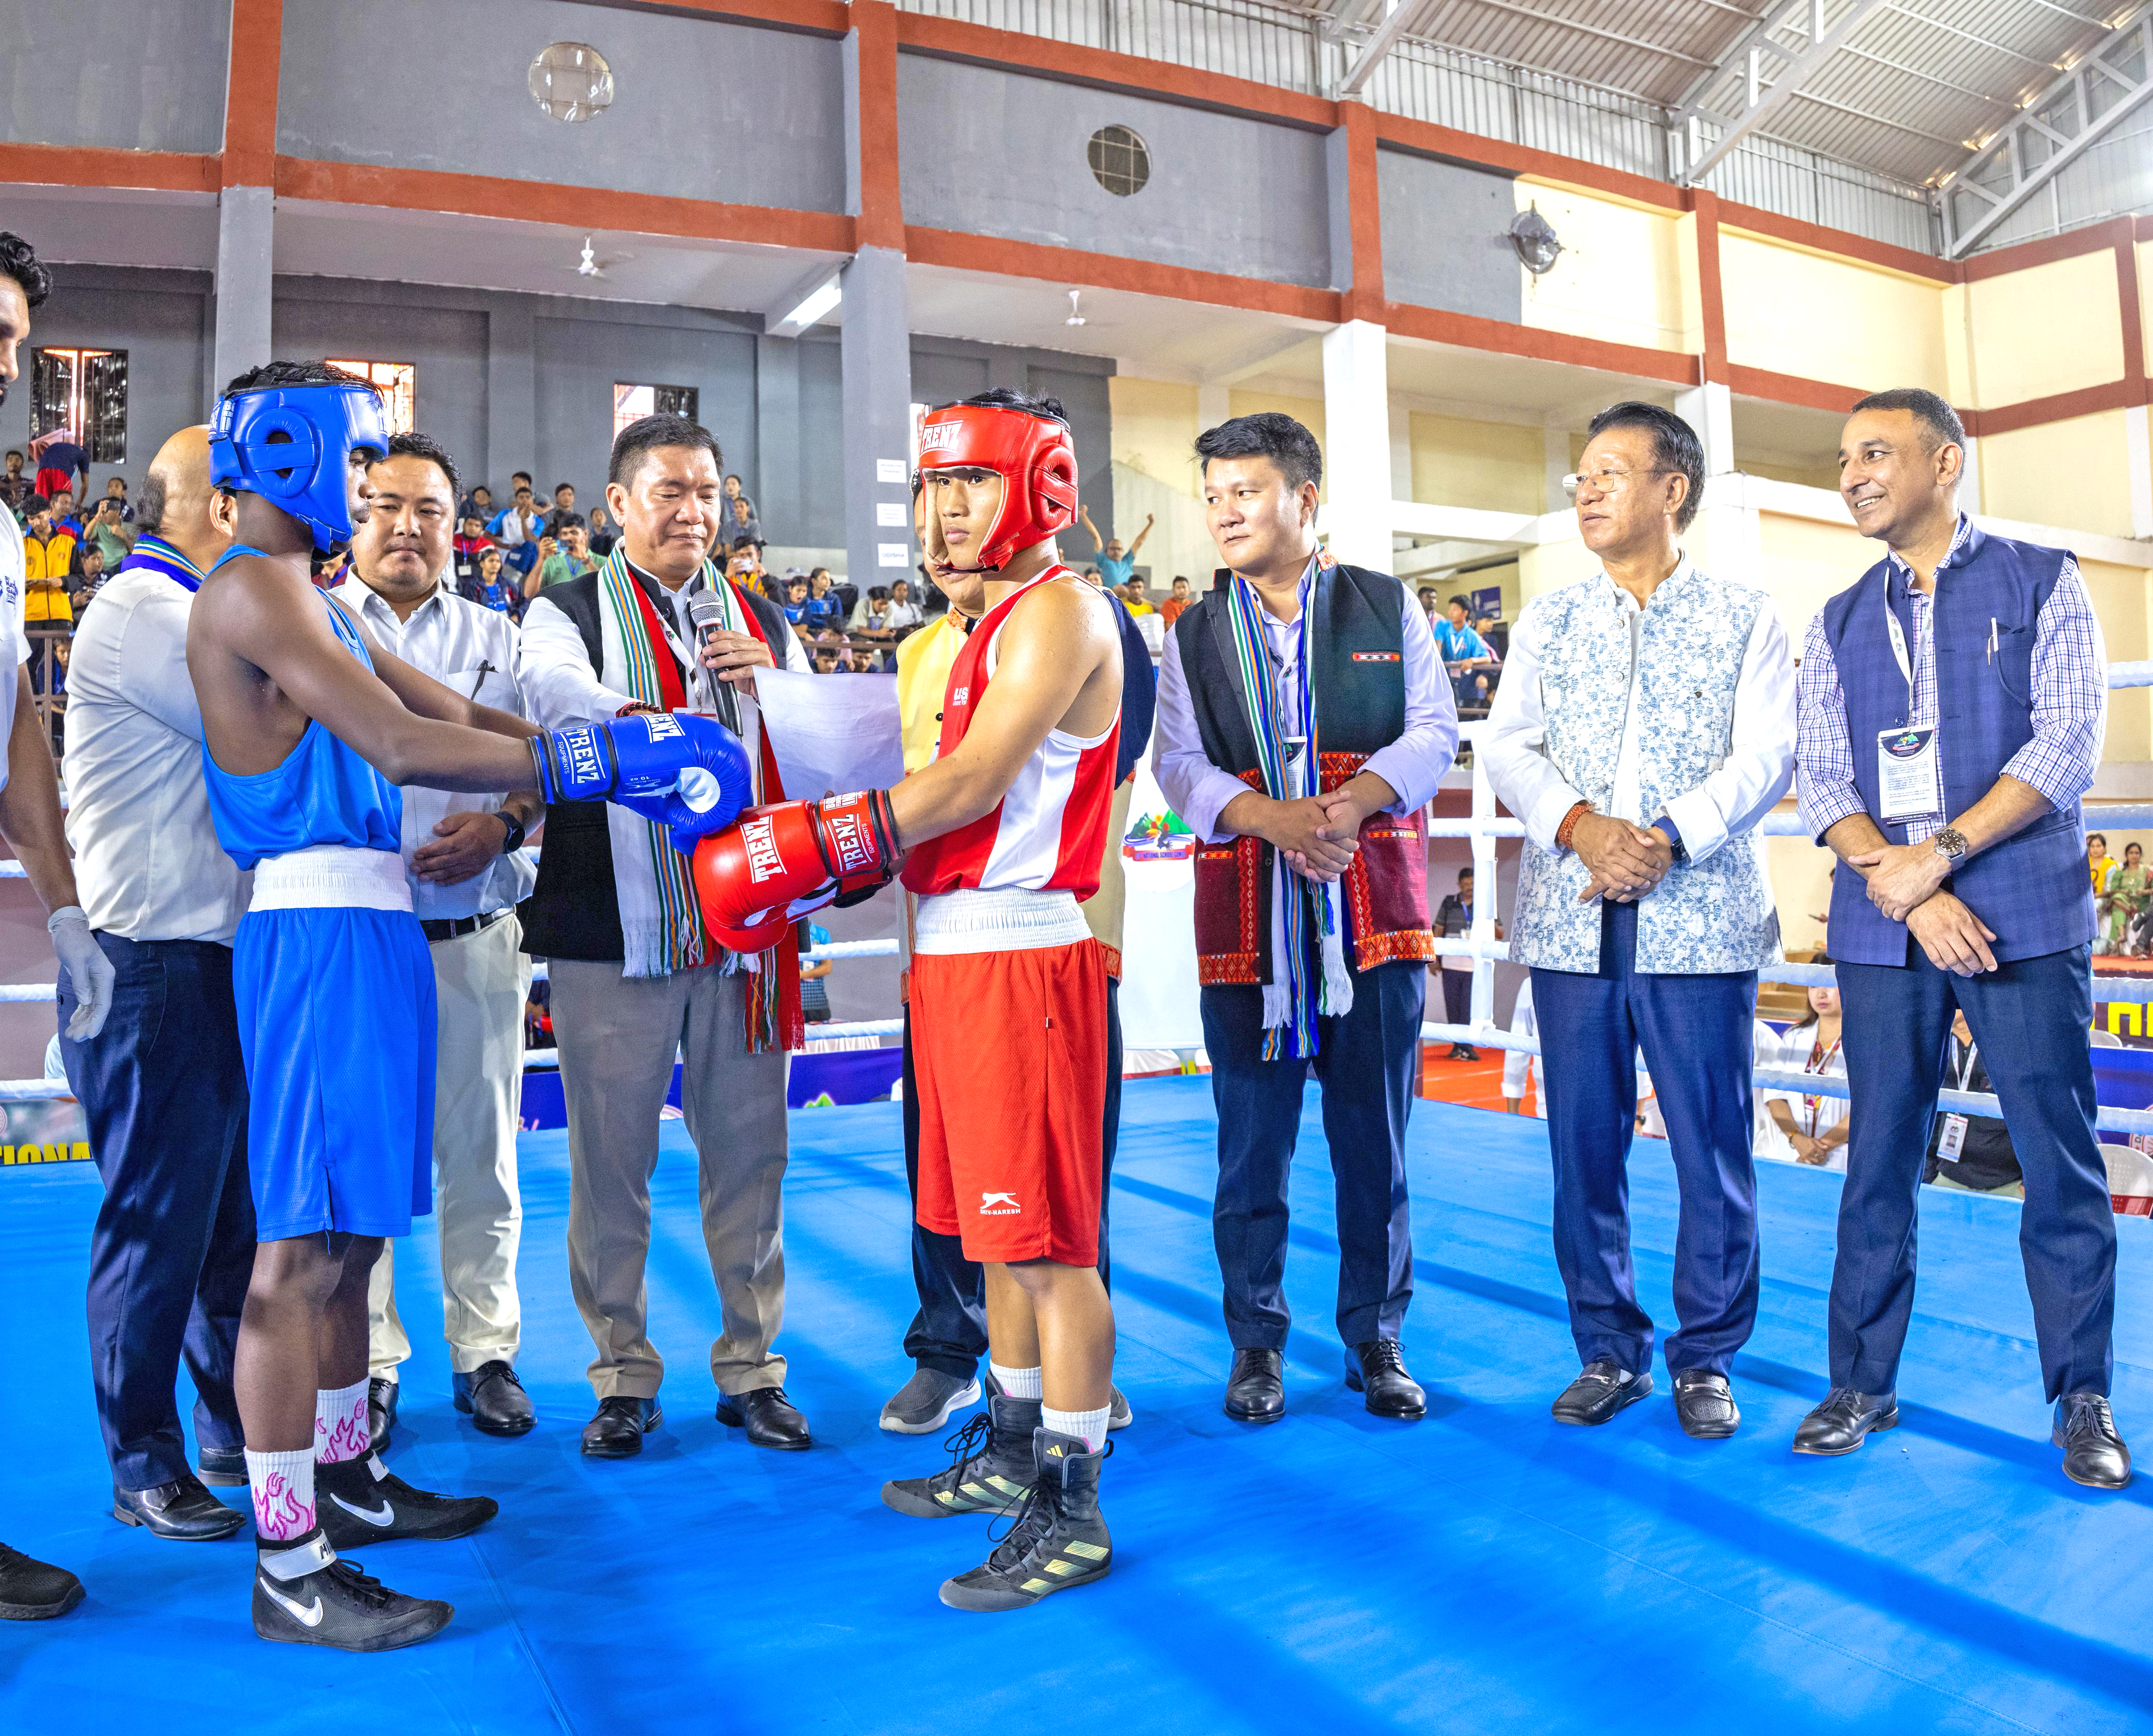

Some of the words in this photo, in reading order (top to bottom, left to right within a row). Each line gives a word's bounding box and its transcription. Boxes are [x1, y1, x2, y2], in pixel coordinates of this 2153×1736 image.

[921, 423, 963, 453] TRENZ
[558, 742, 570, 774] EQUIPMENTS
[565, 729, 600, 784] TRENZ
[742, 816, 784, 883] TRENZ
[831, 814, 867, 871] TRENZ
[861, 823, 875, 854] EQUIPMENTS
